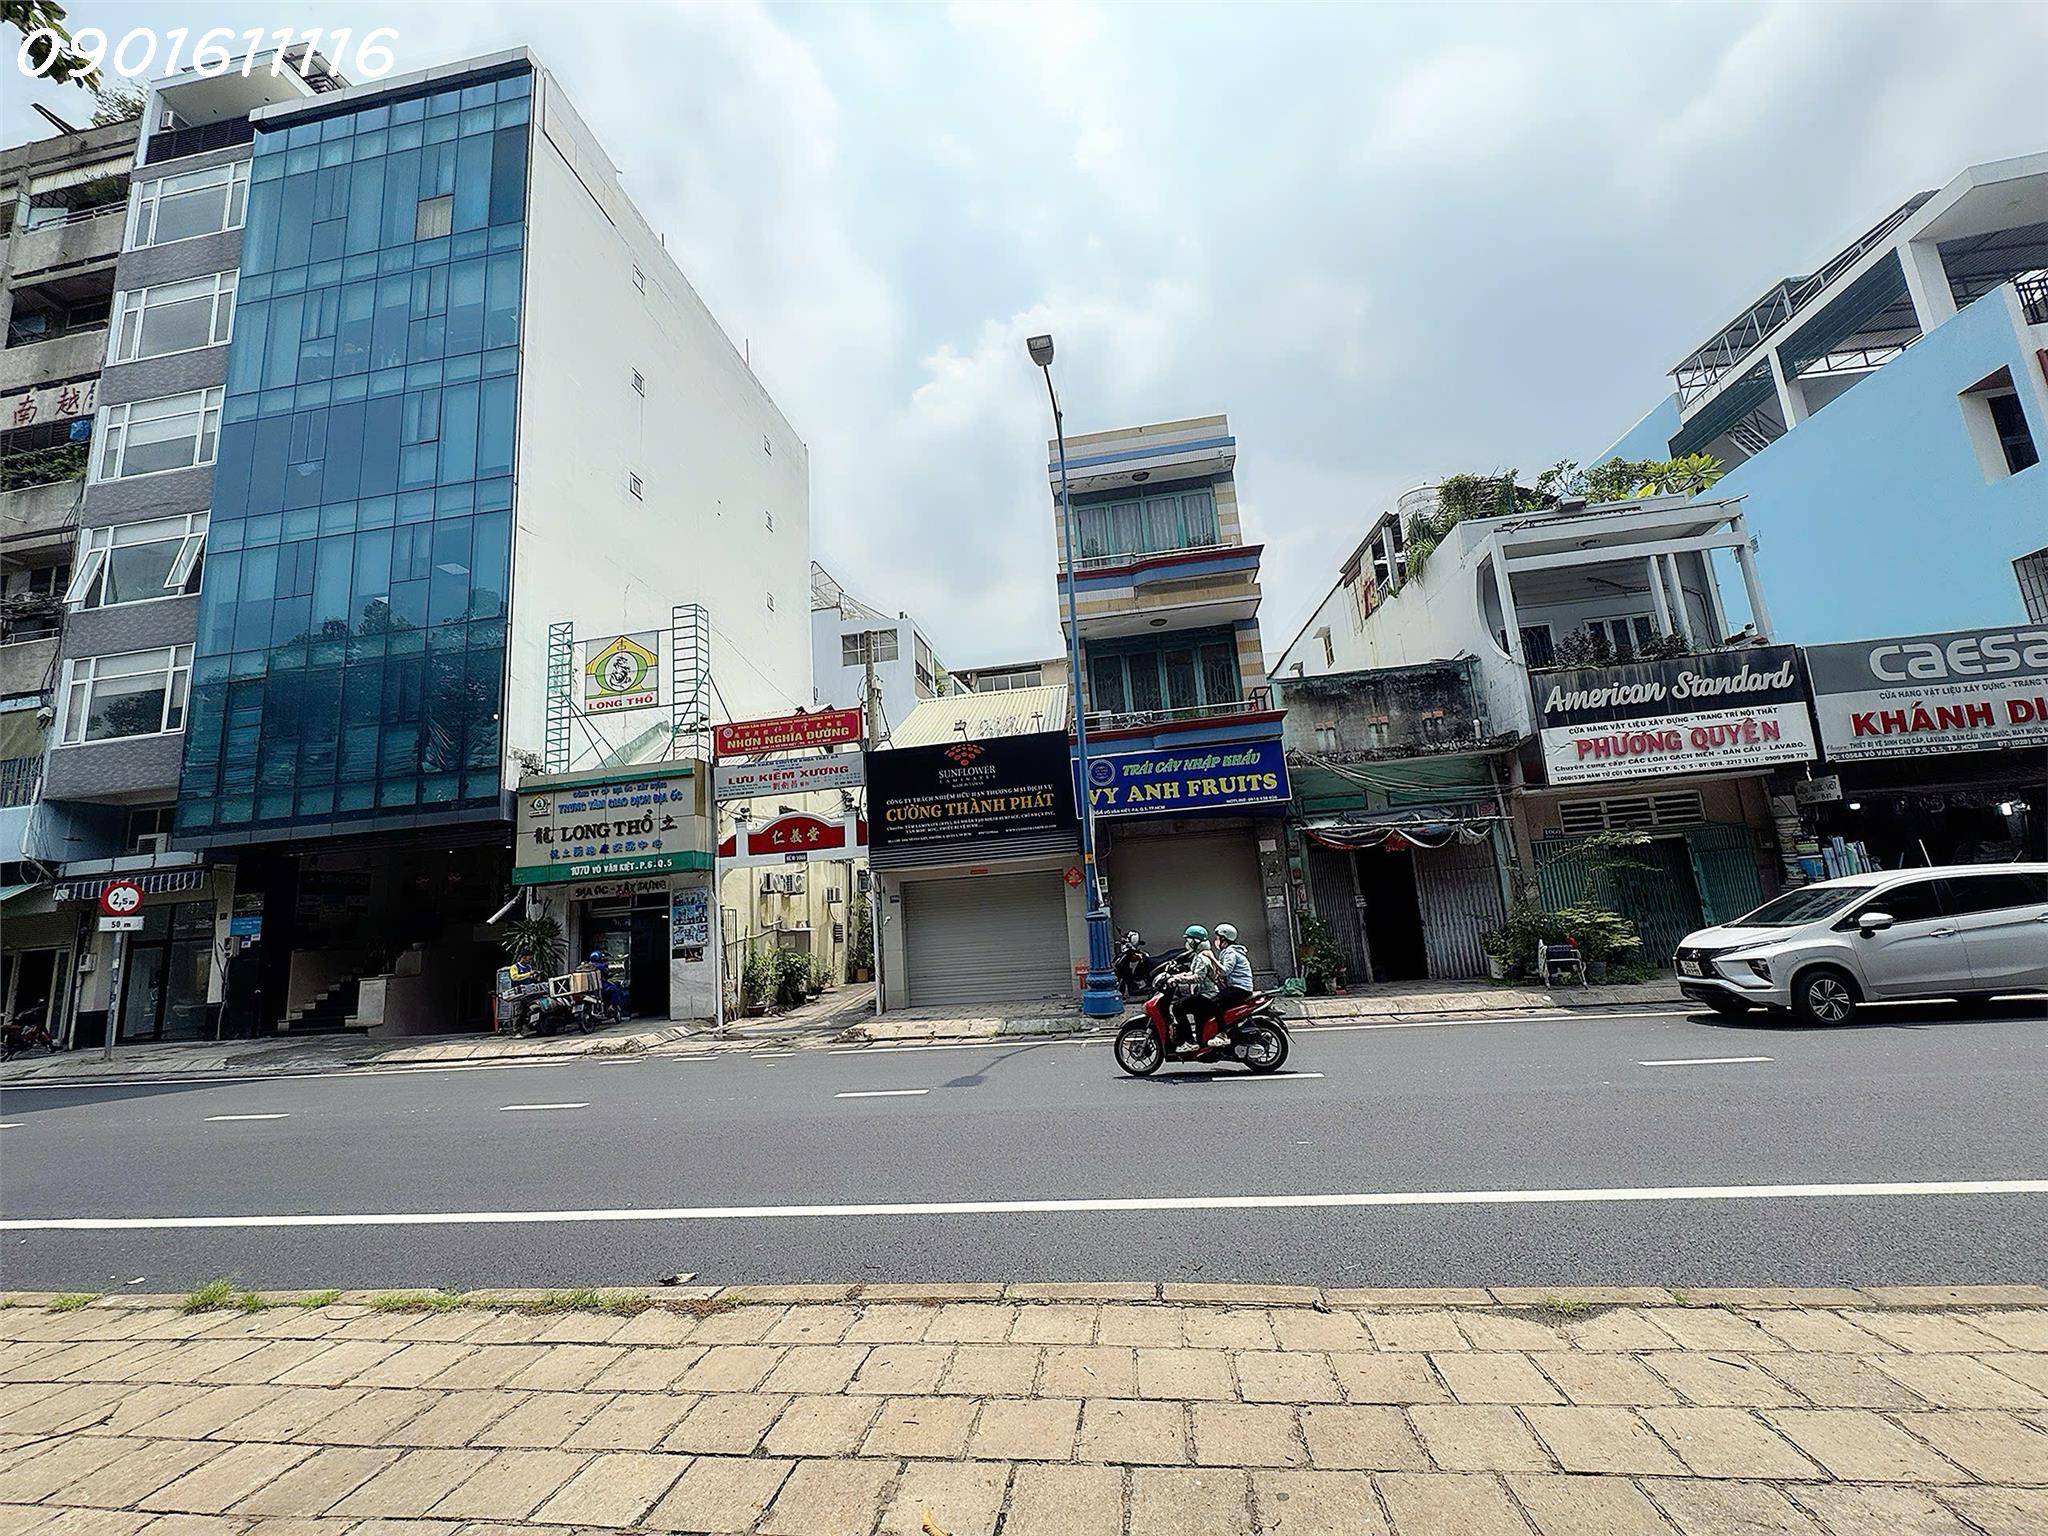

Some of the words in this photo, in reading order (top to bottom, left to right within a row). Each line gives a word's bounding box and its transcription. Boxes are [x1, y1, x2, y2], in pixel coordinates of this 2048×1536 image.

[1544, 681, 1667, 714] American
[1671, 660, 1795, 700] Standard
[1880, 690, 1897, 700] CỬA
[1899, 689, 1922, 698] HÀNG
[1923, 687, 1940, 698] VẬT
[1942, 685, 1961, 696] LIỆU
[1963, 683, 1980, 693] XÂY
[1982, 681, 2006, 692] DỰNG
[2013, 679, 2042, 688] TRANG
[588, 701, 623, 710] LONG
[1568, 726, 1585, 735] CỬA
[1586, 724, 1609, 732] HÀNG
[1610, 722, 1626, 730] VẬT
[1628, 720, 1647, 729] LIỆU
[1648, 718, 1665, 726] XÂY
[1666, 716, 1689, 725] DỰNG
[1695, 713, 1722, 721] TRANG
[1740, 708, 1755, 717] NỘI
[1850, 701, 1995, 737] KHÁNH
[727, 737, 761, 749] NHƠN
[765, 732, 803, 745] NGHĨA
[806, 727, 850, 740] ĐƯỜNG
[1575, 729, 1682, 761] PHƯƠNG
[1690, 717, 1781, 751] QUYÊN
[728, 775, 755, 785] LƯU
[800, 765, 849, 778] XƯƠNG
[938, 765, 996, 779] SUNFLOWER
[1122, 760, 1153, 776] TRÁI
[1155, 758, 1183, 773] CÂY
[1183, 754, 1222, 771] NHẬP
[1127, 780, 1181, 803] ANH
[1187, 773, 1278, 798] FRUITS
[886, 803, 942, 822] CƯỜNG
[945, 797, 1006, 817] THÀNH
[1009, 791, 1055, 810] PHÁT
[561, 822, 610, 843] LONG
[613, 809, 654, 837] THỔ
[570, 864, 590, 876] 1070
[603, 862, 618, 873] VĂN
